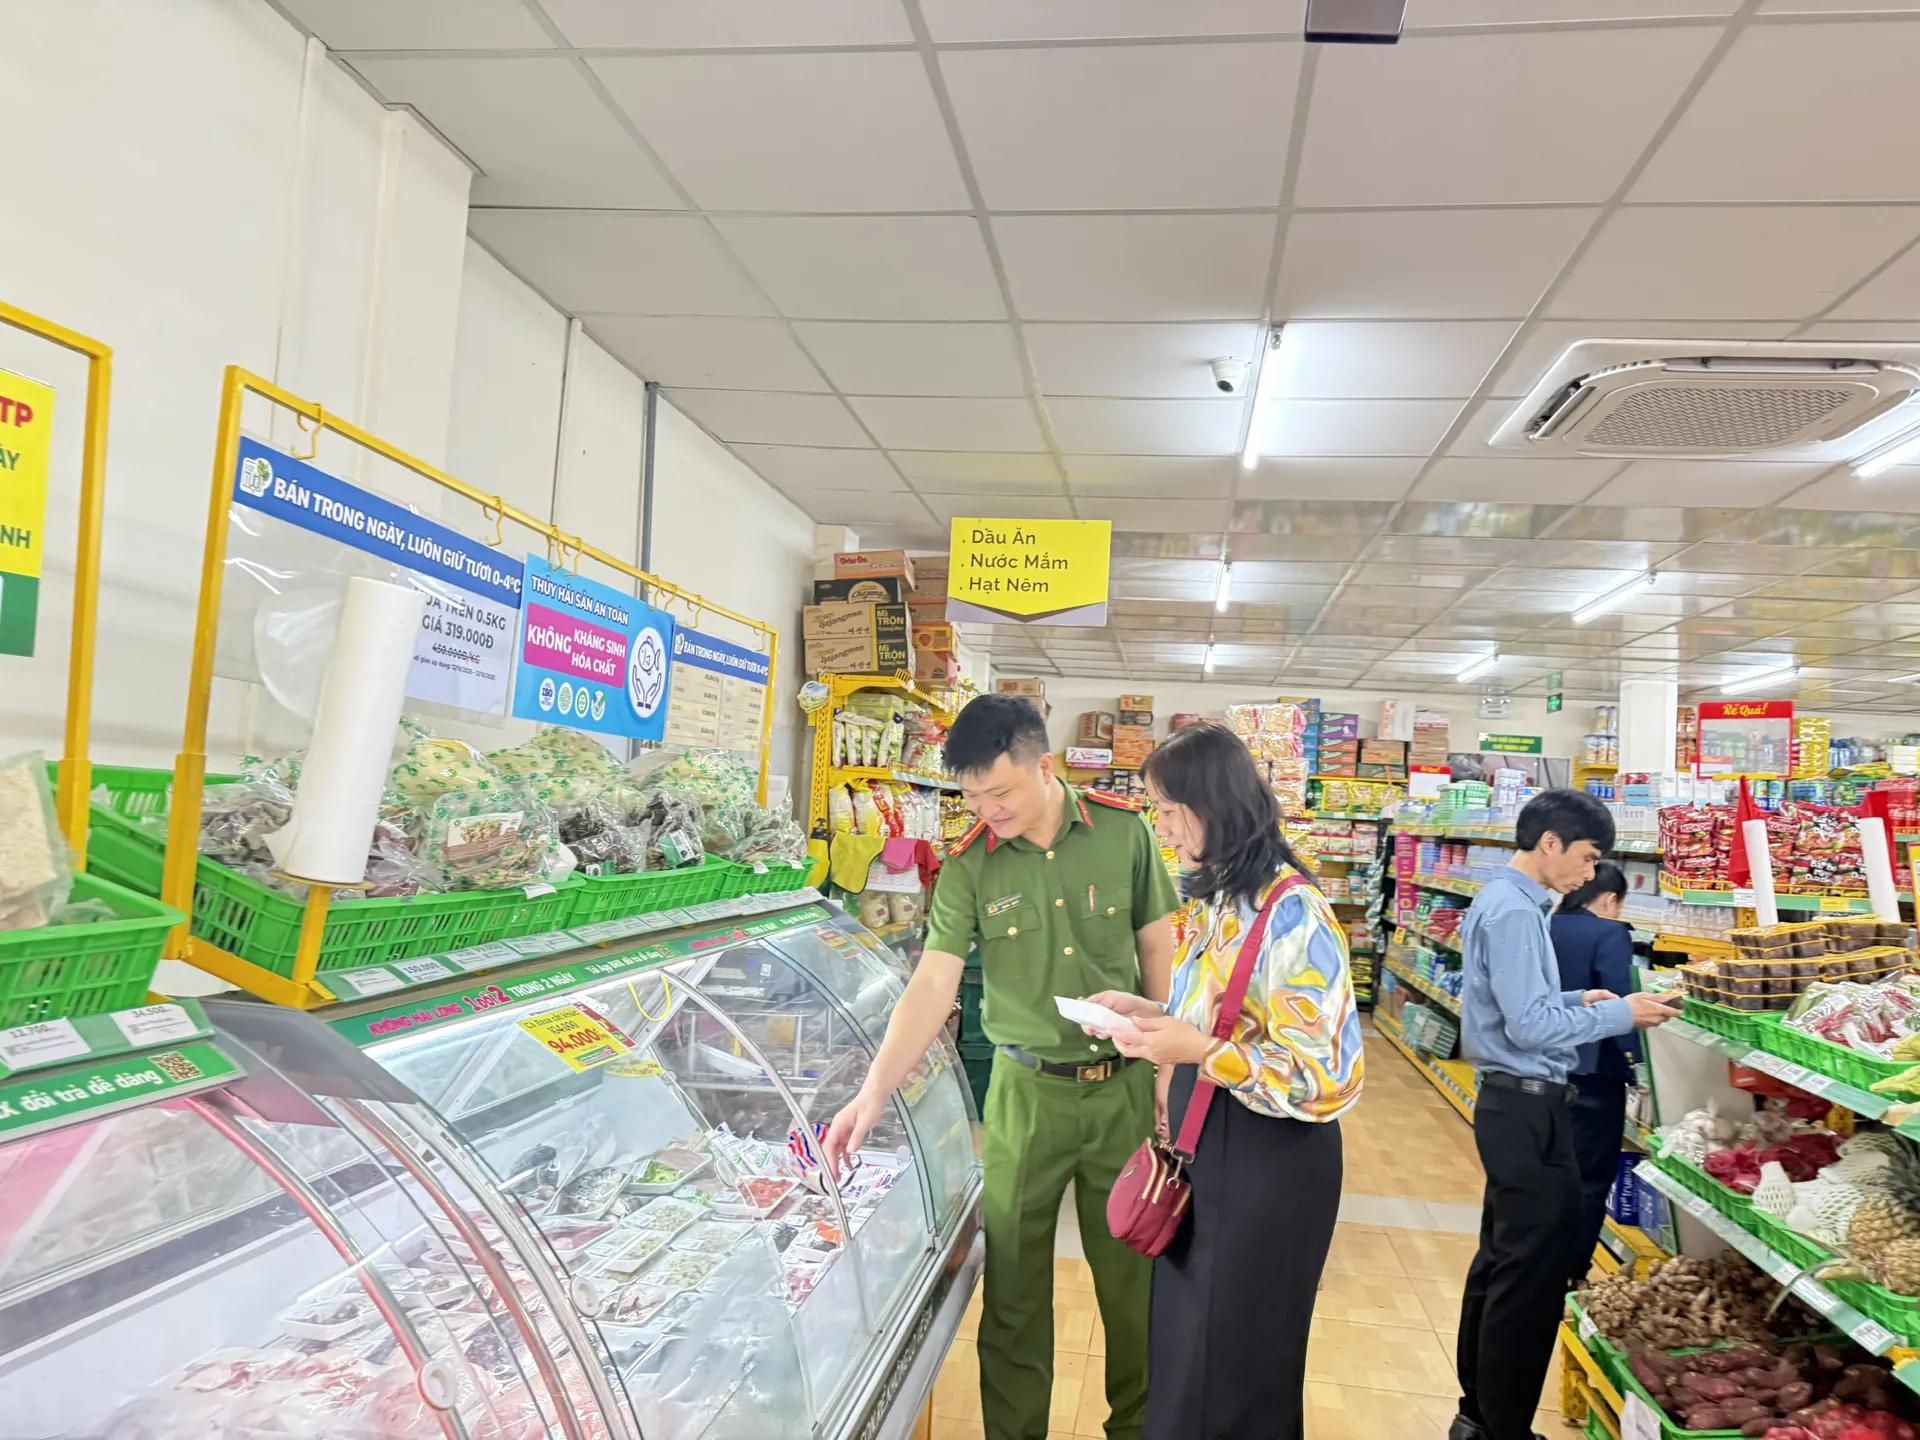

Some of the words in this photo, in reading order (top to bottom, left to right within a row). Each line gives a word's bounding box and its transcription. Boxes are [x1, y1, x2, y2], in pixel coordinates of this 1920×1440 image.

[273, 477, 311, 509] BÁN
[312, 492, 365, 531] TRONG
[366, 516, 406, 551] NGÀY,
[407, 533, 443, 562] LUÔN
[442, 548, 467, 571] GIỮ
[466, 557, 492, 583] TƯƠI
[972, 528, 1006, 545] Dầu
[1012, 527, 1036, 545] Ăn
[970, 553, 1018, 569] Nước
[1024, 551, 1068, 570] Mắm
[969, 577, 1000, 595] Hạt
[1006, 578, 1049, 593] Nêm
[531, 574, 557, 598] THỦY
[557, 584, 574, 606] HẢI
[575, 590, 594, 612] SẢN
[594, 602, 607, 617] AN
[607, 606, 630, 627] TOÀN
[476, 609, 506, 630] 0.5KG
[877, 615, 905, 626] TRỘN
[421, 614, 442, 634] GIÁ
[445, 621, 494, 649] 319.000Đ
[526, 623, 572, 654] KHÔNG
[573, 628, 606, 652] KHÁNG
[605, 640, 626, 658] SINH
[571, 651, 592, 671] HÓA
[593, 658, 616, 677] CHẤT
[879, 650, 906, 661] TRỘN
[1722, 703, 1738, 716] Rẻ
[1739, 702, 1769, 717] Quá!
[507, 980, 545, 998] TRONG
[541, 978, 555, 989] 2
[551, 971, 577, 986] NGÀY
[19, 1090, 57, 1111] đổi
[54, 1084, 89, 1102] trả
[87, 1076, 116, 1096] dễ
[114, 1070, 165, 1089] dàng
